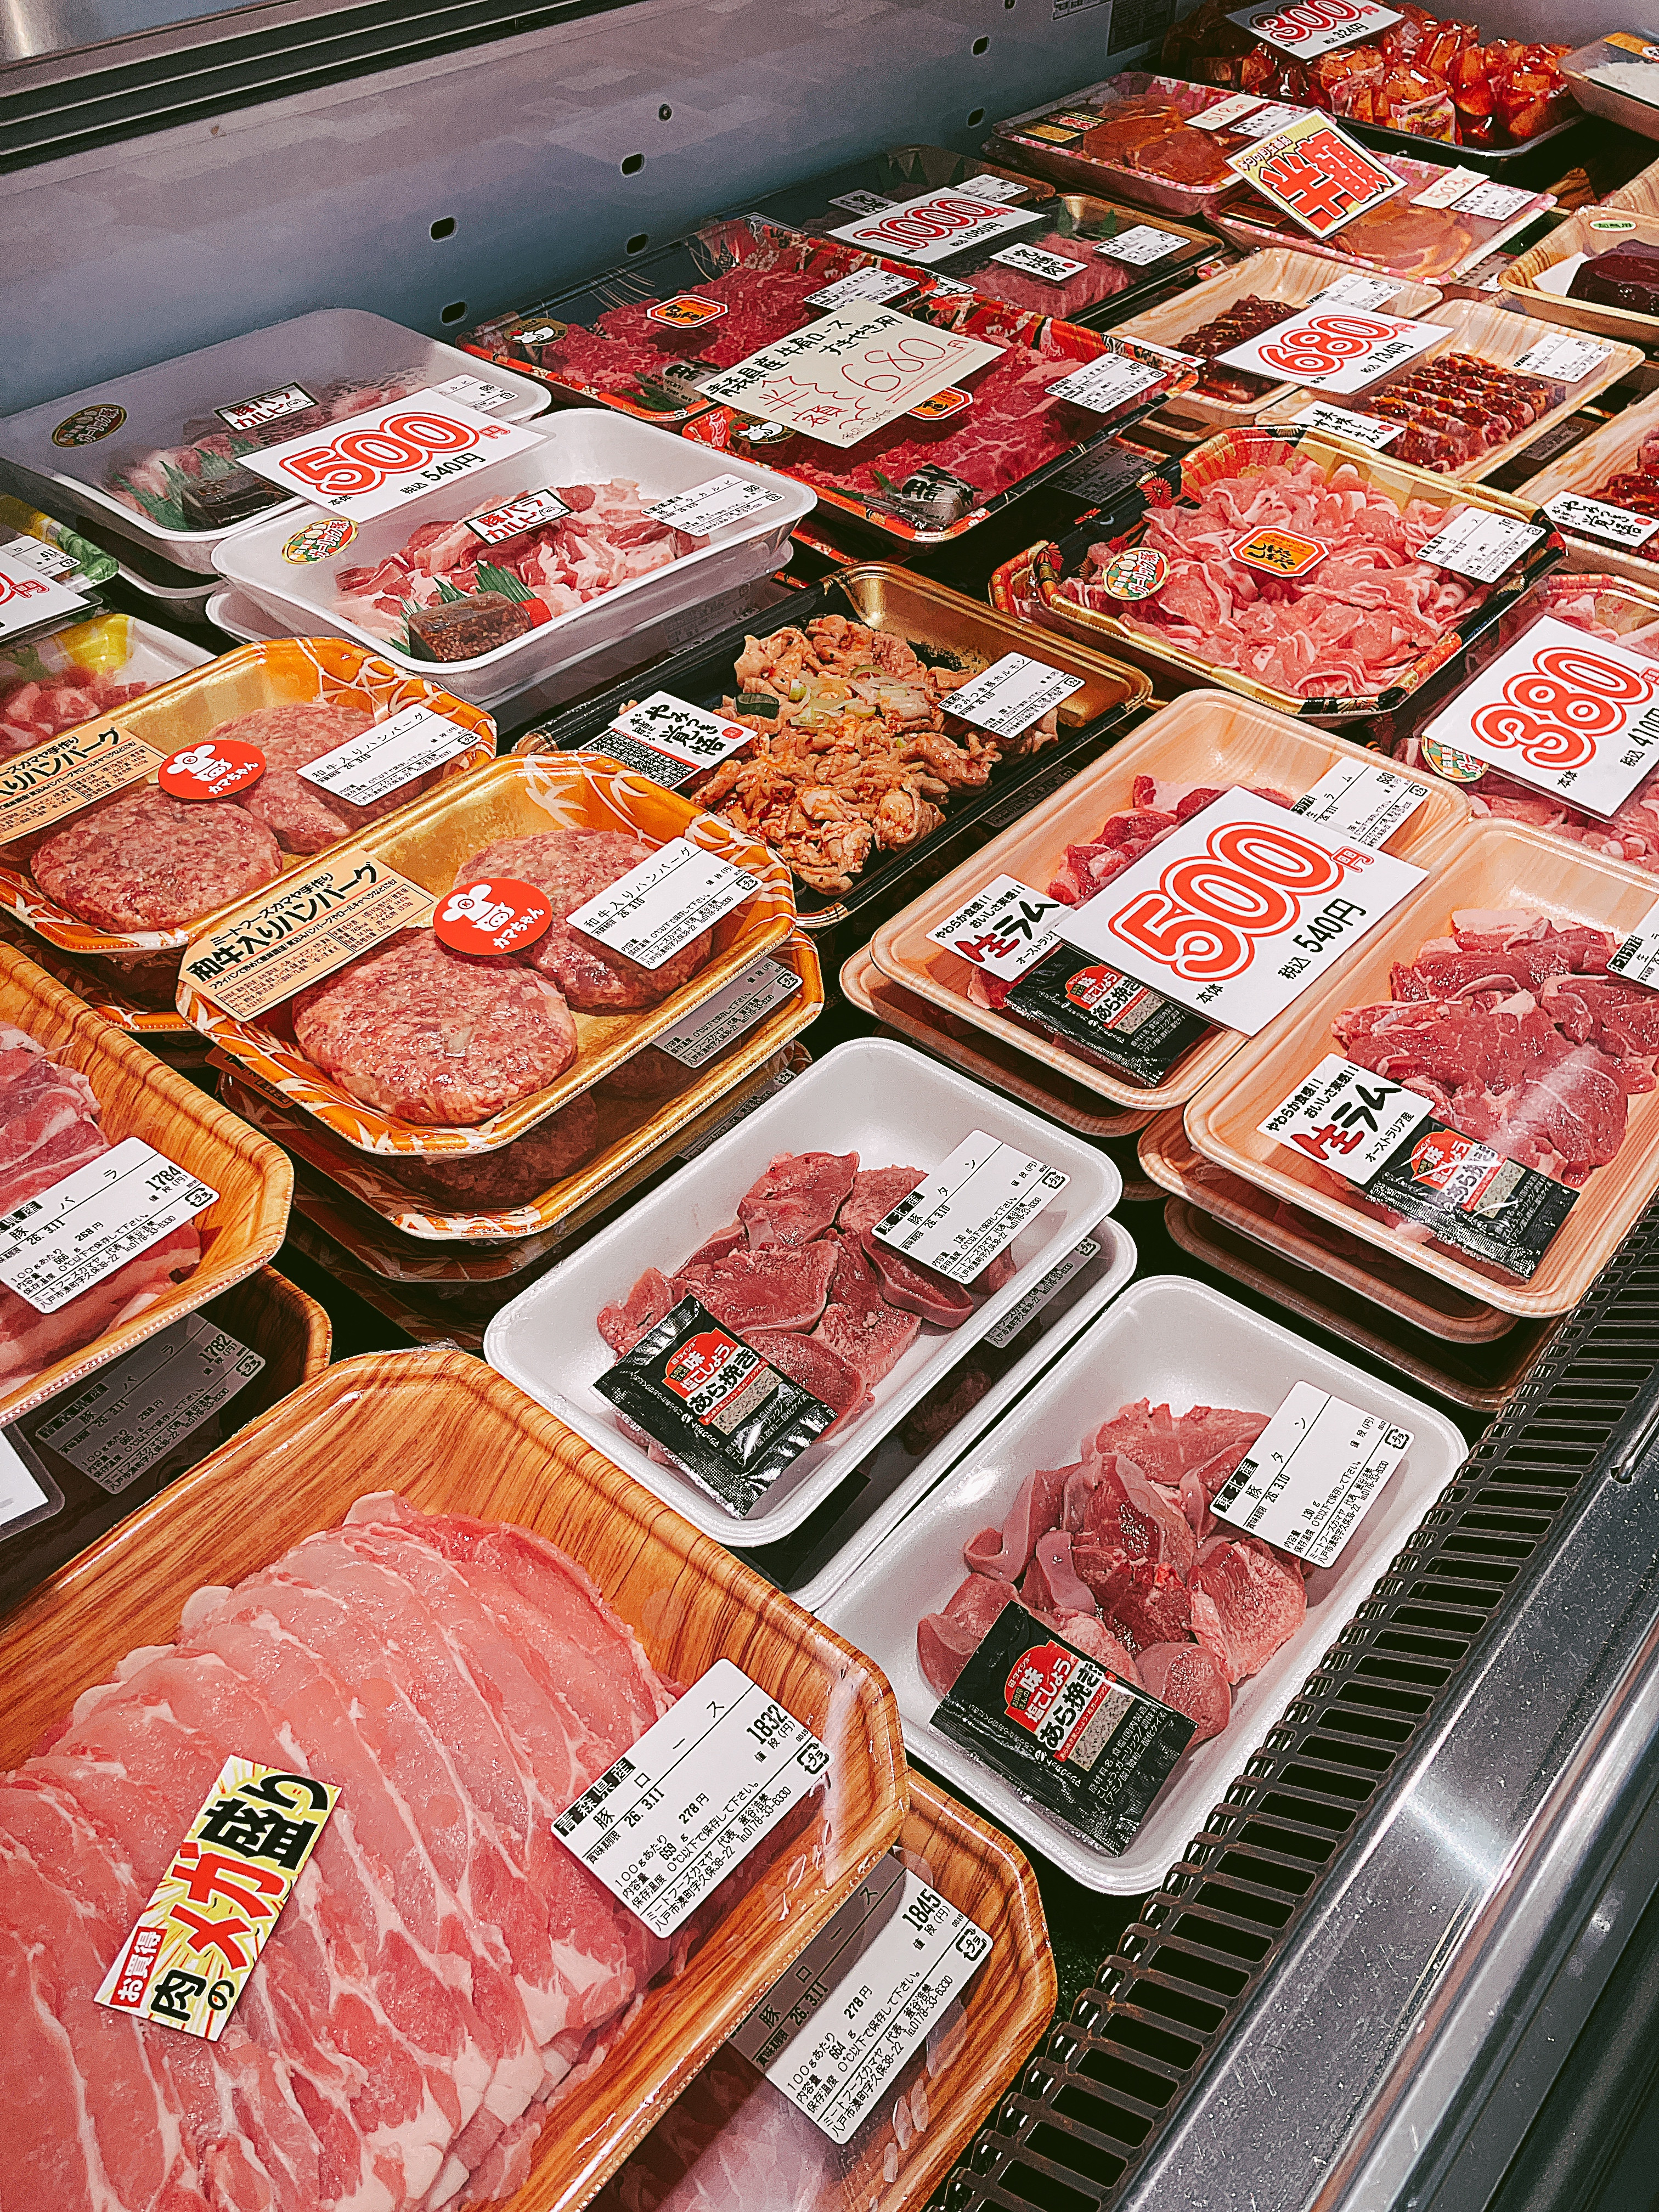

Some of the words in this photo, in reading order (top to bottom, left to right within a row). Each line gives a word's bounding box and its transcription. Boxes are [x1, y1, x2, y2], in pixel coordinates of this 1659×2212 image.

[1260, 128, 1393, 230] 半額
[421, 453, 486, 483] 540円
[479, 499, 544, 526] 豚バラ
[486, 512, 538, 538] カルビ
[312, 713, 422, 777] 和牛入りハンバーグ
[645, 704, 718, 734] やみつき
[207, 760, 259, 795] カマちゃん
[1557, 770, 1579, 788] 本体
[1620, 749, 1645, 767] 税込
[210, 872, 334, 945] ミートフーズカマヤ手作り
[584, 847, 689, 928] 和牛入りハンバーグ
[186, 861, 379, 983] 和牛入りハンバーグ
[492, 907, 545, 950] カマちゃん
[953, 900, 1060, 963] 生ラム
[1292, 897, 1368, 954] 540円
[1195, 983, 1224, 1005] 本体
[1277, 956, 1312, 980] 税込
[1289, 1083, 1402, 1161] 生ラム
[1364, 1111, 1415, 1163] オーストラリア産
[9, 1170, 116, 1240] 豚バラ
[145, 1166, 182, 1190] 1784
[907, 1160, 975, 1226] 豚タン
[44, 1220, 65, 1233] 3.11
[877, 1193, 922, 1233] 東北産
[924, 1220, 938, 1228] 26.
[934, 1205, 950, 1218] 3.10
[59, 1215, 148, 1271] 0℃以下で保存して下さい。
[932, 1252, 950, 1267] 内容量
[953, 1235, 966, 1244] 130
[940, 1251, 962, 1271] 保存温度
[952, 1236, 992, 1276] ミートフーズカマヤ
[993, 1223, 1007, 1234] 代表
[16, 1269, 42, 1290] 内容量
[35, 1257, 104, 1304] ミートフーズカマヤ
[196, 1334, 235, 1363] 1782
[680, 1342, 732, 1392] 塩こしょう
[685, 1350, 706, 1371] 味
[76, 1343, 179, 1424] 豚バラ
[687, 1347, 760, 1414] あら挽き
[1215, 1460, 1257, 1509] 東北産
[1245, 1418, 1305, 1499] 豚タン
[1246, 1506, 1267, 1530] 賞味期限
[1265, 1492, 1279, 1503] 26.
[1273, 1474, 1290, 1489] 3.10
[1284, 1530, 1301, 1548] 内容量
[1302, 1509, 1314, 1520] 130
[1294, 1529, 1315, 1553] 保存温度
[1312, 1462, 1361, 1526] 0℃以下で保存して下さい。
[1310, 1509, 1345, 1559] ミートフーズカマヤ
[1344, 1494, 1358, 1506] 代表
[1013, 1652, 1031, 1682] ダイショー
[1019, 1666, 1043, 1692] 味
[1025, 1657, 1072, 1722] 塩こしょう
[747, 1705, 787, 1745] 1832
[1038, 1661, 1105, 1750] あら挽き
[593, 1701, 724, 1830] 豚ロース
[555, 1758, 634, 1835] 青森県産
[586, 1831, 620, 1864] 賞味期限
[624, 1811, 644, 1827] 26.
[641, 1788, 664, 1810] 3.11
[632, 1874, 667, 1909] 保存温度
[667, 1783, 758, 1871] 0℃以下で保存して下さい。
[615, 1835, 667, 1887] 100gあたり
[623, 1873, 650, 1899] 内容量
[659, 1843, 676, 1860] 659
[647, 1851, 713, 1920] ミートフーズカマヤ
[718, 1829, 737, 1848] 代表
[656, 1846, 735, 1931] 八戸市湊町字久保38-22
[902, 1888, 941, 1931] 1845
[117, 1929, 161, 2002] お買得
[757, 1887, 883, 2029] 豚ロース
[790, 2007, 809, 2026] 26.
[805, 1982, 828, 2006] 3.11
[788, 2033, 834, 2090] 100gあたり
[807, 2075, 839, 2114] 保存温度
[838, 1972, 919, 2072] 0℃以下で保存して下さい。
[796, 2074, 822, 2104] 内容量
[829, 2041, 846, 2059] 664
[823, 2048, 882, 2126] ミートフーズカマヤ
[885, 2023, 904, 2044] 代表
[832, 2042, 904, 2137] 八戸市湊町字久保38-22
